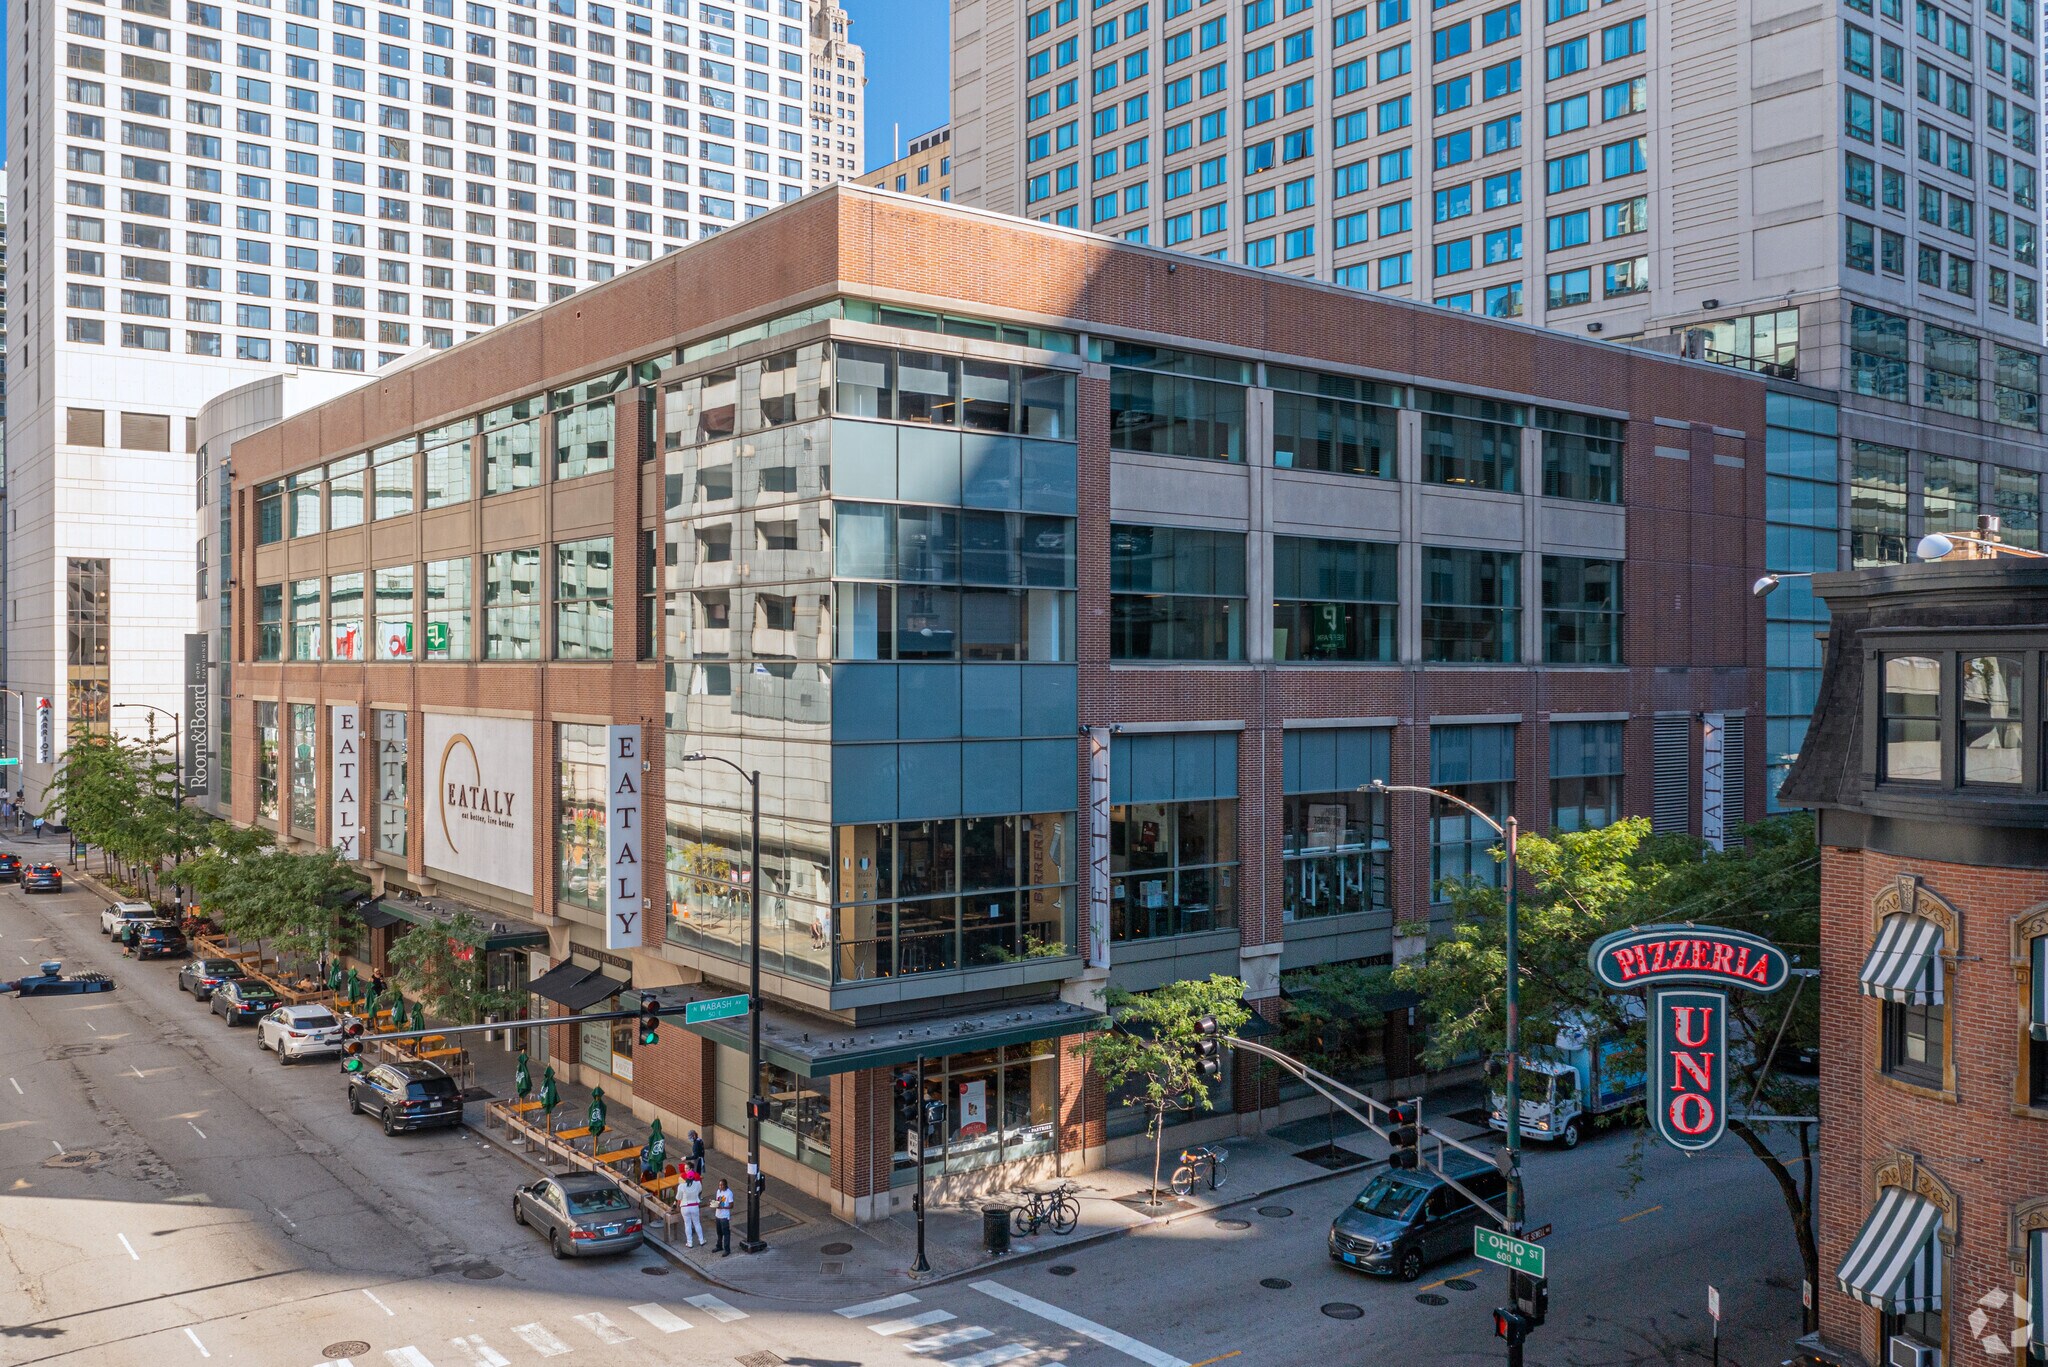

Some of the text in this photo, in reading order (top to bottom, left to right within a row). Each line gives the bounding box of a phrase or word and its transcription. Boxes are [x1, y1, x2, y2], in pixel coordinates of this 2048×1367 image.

[41, 709, 49, 762] MARRIOTT
[187, 682, 207, 789] Room&Board
[339, 714, 356, 852] EATALY
[448, 783, 515, 817] EATALY
[1705, 722, 1722, 840] EATALY
[470, 812, 487, 824] better,
[487, 815, 497, 825] live
[498, 817, 514, 829] better
[616, 737, 637, 935] EATALY
[1092, 736, 1108, 905] EATALY
[611, 957, 628, 968] FOOD
[1611, 939, 1769, 985] PIZZERIA
[700, 1000, 732, 1012] WABASH
[1669, 1006, 1715, 1135] UNO
[1480, 1233, 1485, 1242] E
[1489, 1235, 1525, 1256] OHIO
[1529, 1249, 1539, 1260] ST
[1497, 1253, 1522, 1267] 600 N
